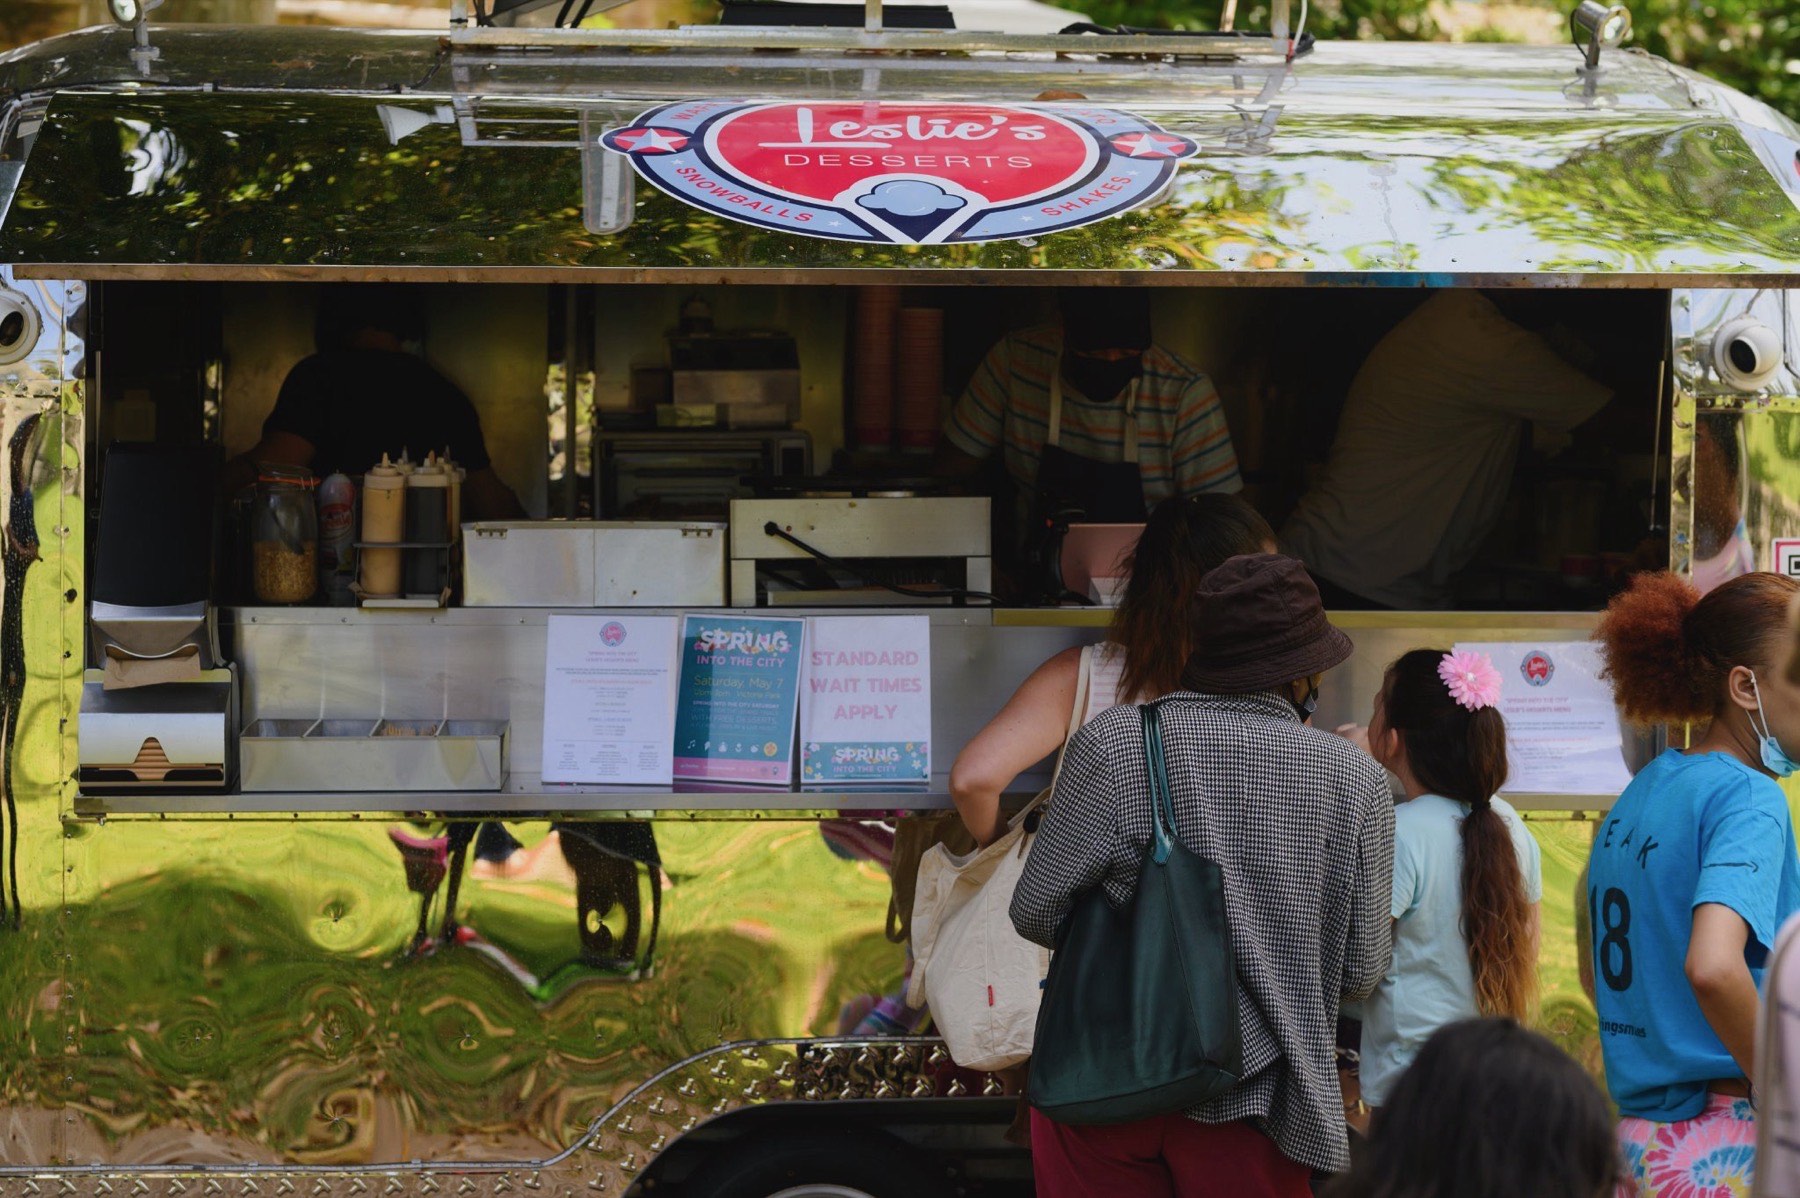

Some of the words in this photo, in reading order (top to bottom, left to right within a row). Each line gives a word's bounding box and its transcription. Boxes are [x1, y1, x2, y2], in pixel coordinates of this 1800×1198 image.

[758, 107, 1047, 148] Leslie's
[784, 154, 1033, 168] DESSERTS
[676, 167, 814, 222] SNOWBALLS
[1041, 176, 1132, 216] SHAKES
[699, 628, 789, 654] SPRING
[696, 655, 726, 666] INTO
[730, 656, 753, 667] THE
[756, 657, 786, 668] CITY
[811, 651, 919, 666] STANDARD
[694, 674, 744, 689] Saturday,
[749, 677, 773, 690] May
[776, 678, 784, 688] 7
[810, 678, 861, 693] WAIT
[867, 678, 922, 693] TIMES
[834, 704, 898, 720] APPLY
[834, 746, 899, 763] SPRING
[833, 765, 855, 773] INTO
[858, 765, 875, 773] THE
[877, 765, 897, 773] CITY
[1590, 884, 1633, 992] 18
